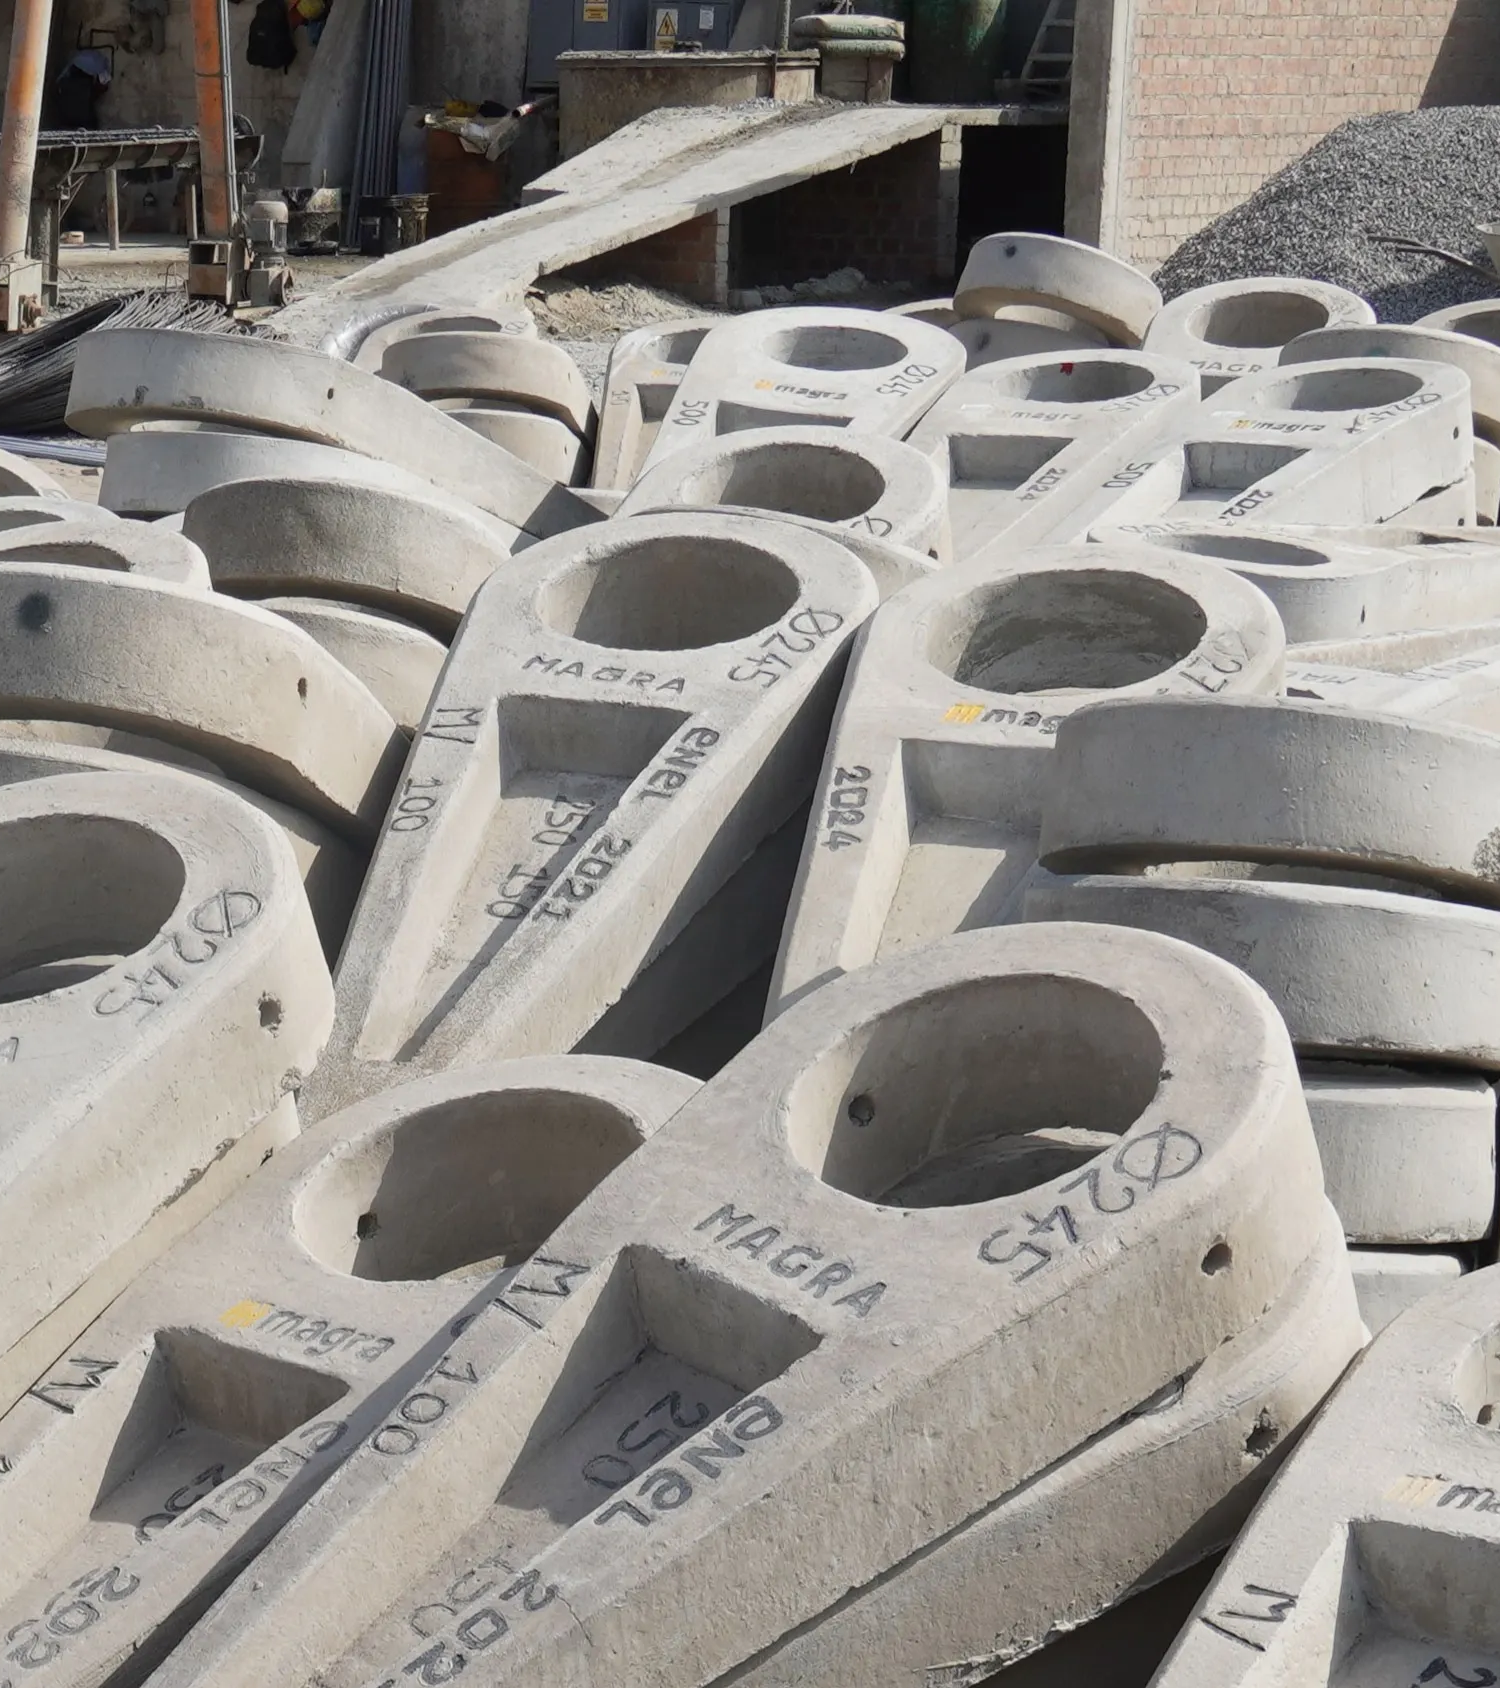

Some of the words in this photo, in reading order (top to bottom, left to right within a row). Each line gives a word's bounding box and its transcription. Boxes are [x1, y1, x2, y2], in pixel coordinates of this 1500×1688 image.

[1189, 359, 1264, 374] MAGR
[980, 707, 1063, 736] mag
[819, 764, 873, 853] 2024
[694, 1201, 892, 1318] MAGRA
